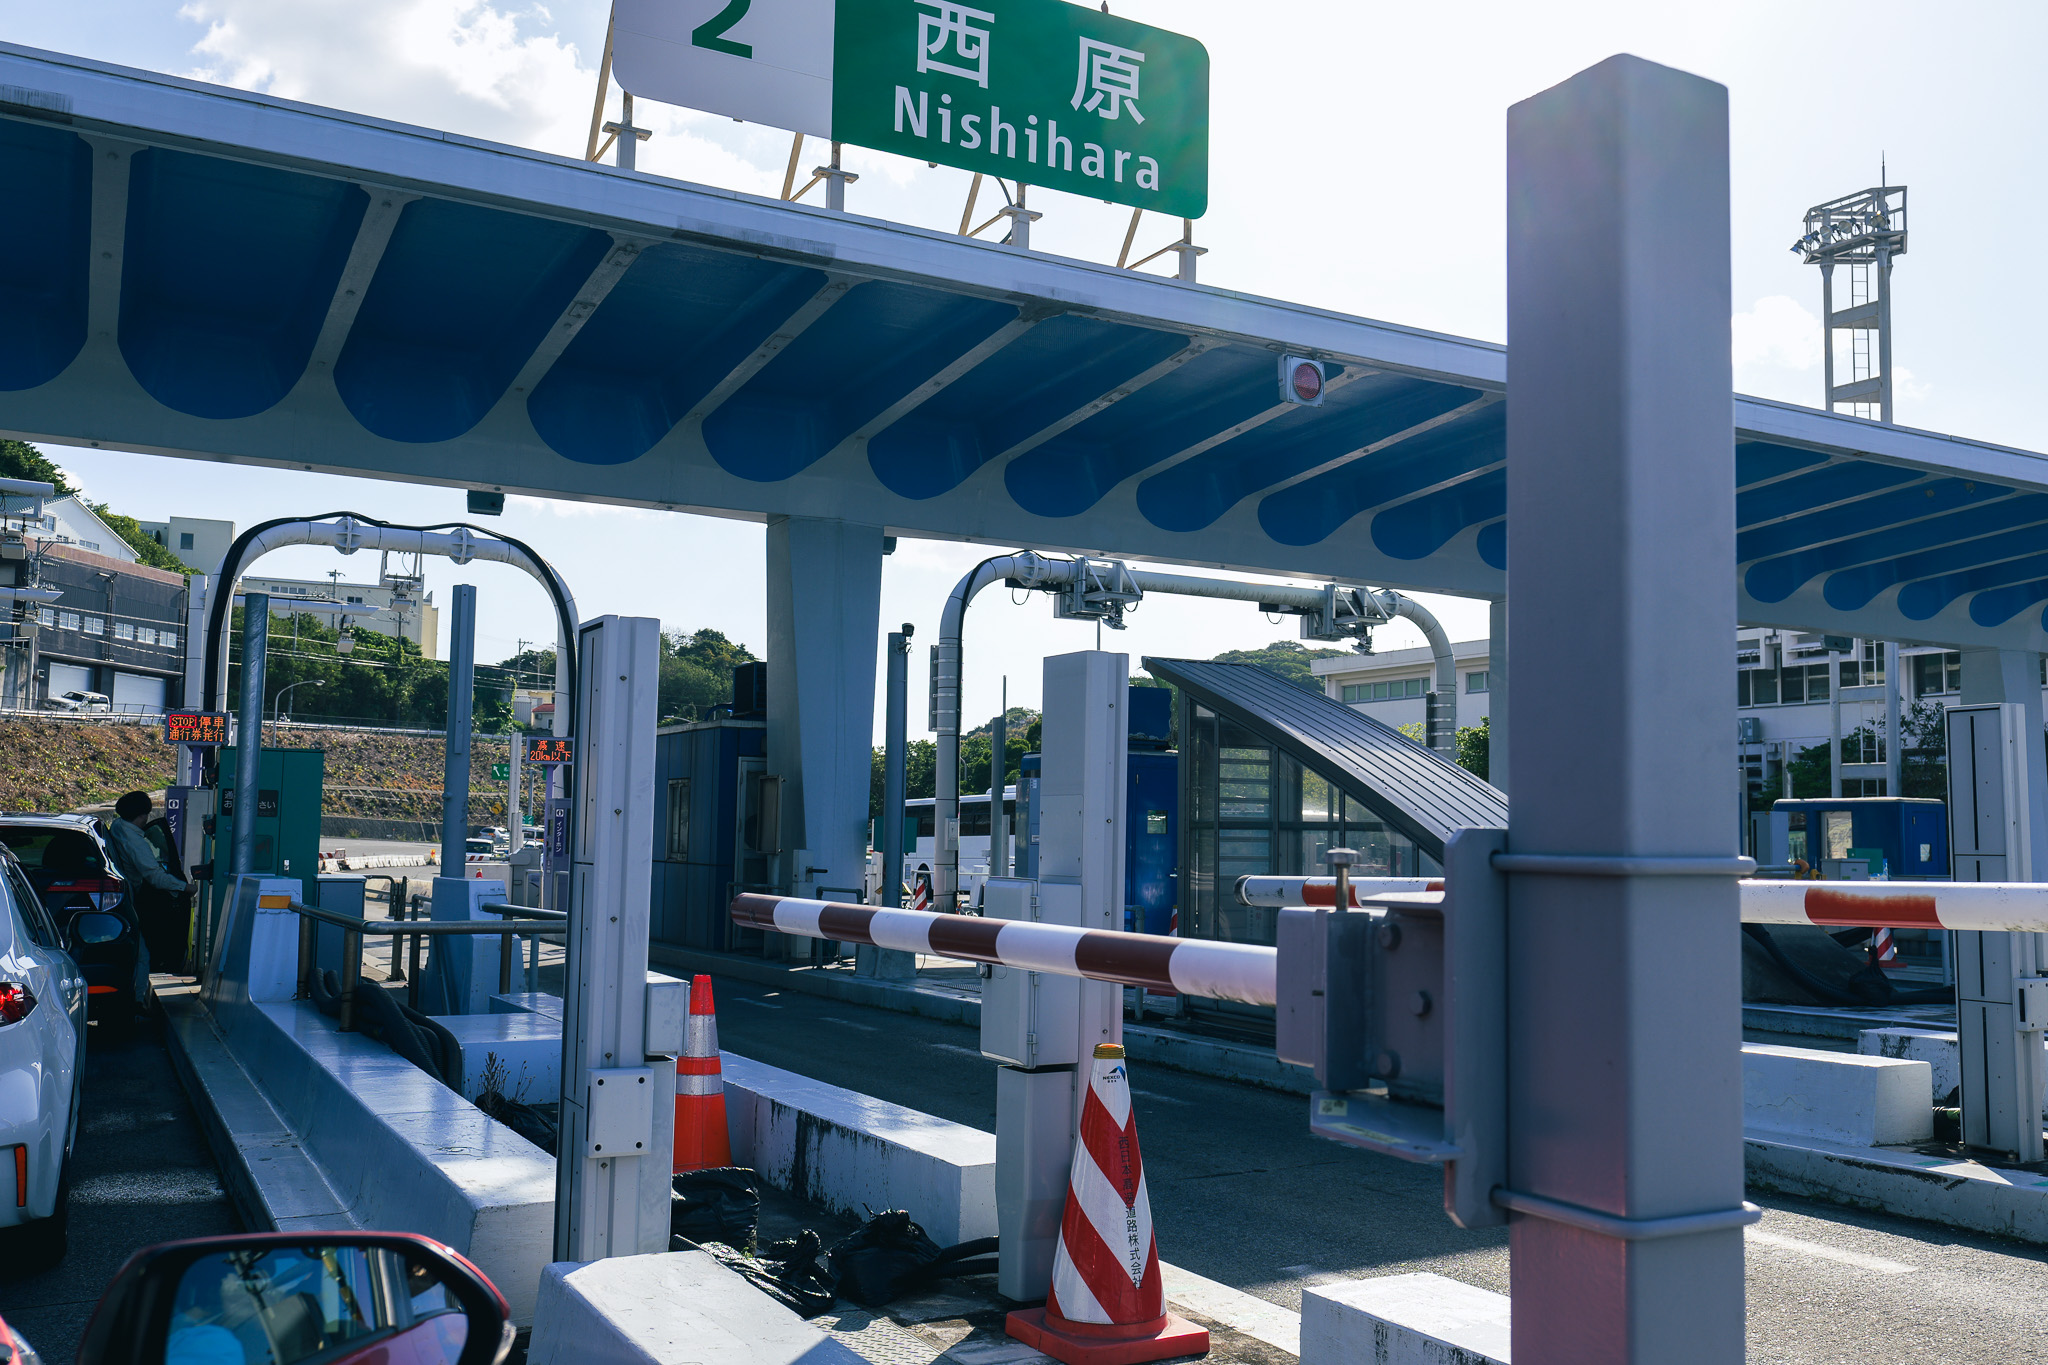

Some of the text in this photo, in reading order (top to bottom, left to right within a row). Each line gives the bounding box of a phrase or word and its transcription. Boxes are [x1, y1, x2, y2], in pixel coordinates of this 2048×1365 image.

[913, 0, 1146, 126] 西原
[894, 84, 1159, 191] Nishihara
[171, 715, 225, 729] STOP 停車
[168, 728, 225, 742] 通行券発行
[537, 739, 566, 751] 減速
[529, 750, 572, 762] 20km以下
[258, 800, 276, 809] さい
[169, 814, 177, 834] インタ
[1117, 1135, 1144, 1290] 西日本高速道路株式会社
